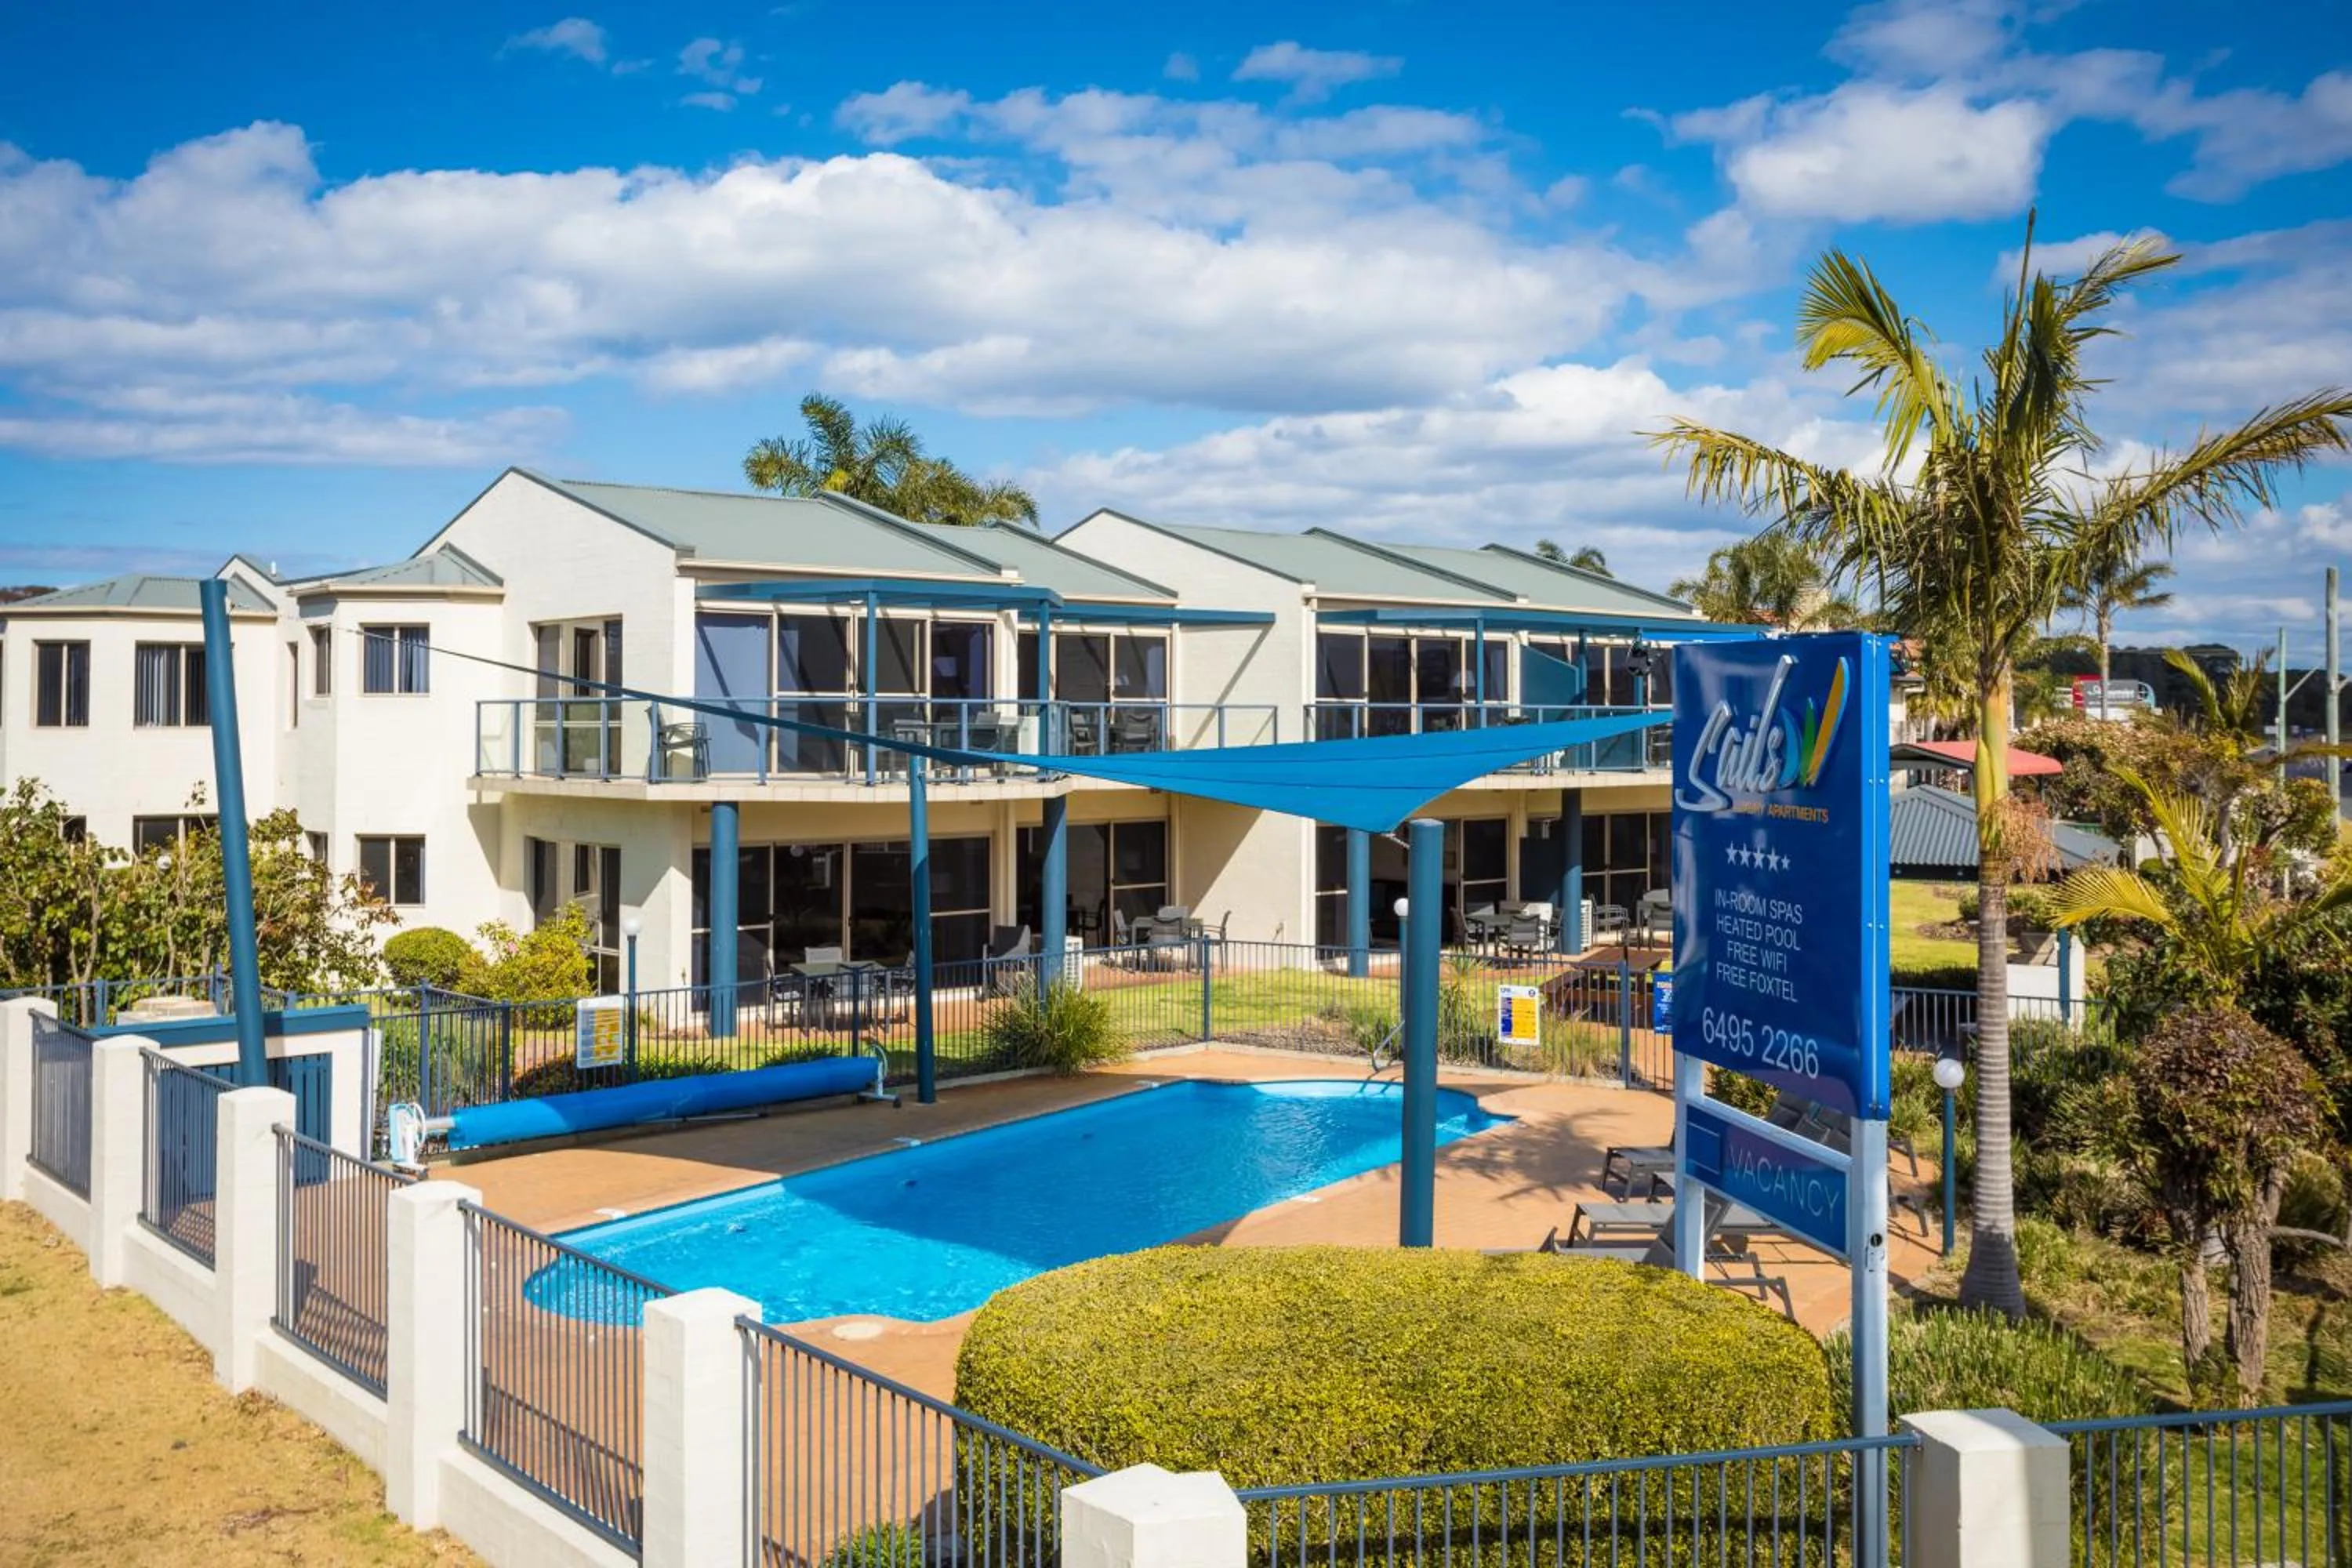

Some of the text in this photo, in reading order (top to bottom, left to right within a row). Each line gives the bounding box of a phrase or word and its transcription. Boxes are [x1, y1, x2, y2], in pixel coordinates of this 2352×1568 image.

[1675, 655, 1793, 811] Sails
[1769, 803, 1829, 824] APARTMENTS
[1715, 888, 1802, 924] IN-ROOM SPAS
[1716, 913, 1801, 951] HEATED POOL
[1727, 940, 1788, 975] FREE WIFI
[1716, 961, 1798, 1003] FREE FOXTEL
[1702, 1007, 1819, 1079] 6495 2266
[1729, 1145, 1840, 1221] VACANCY
